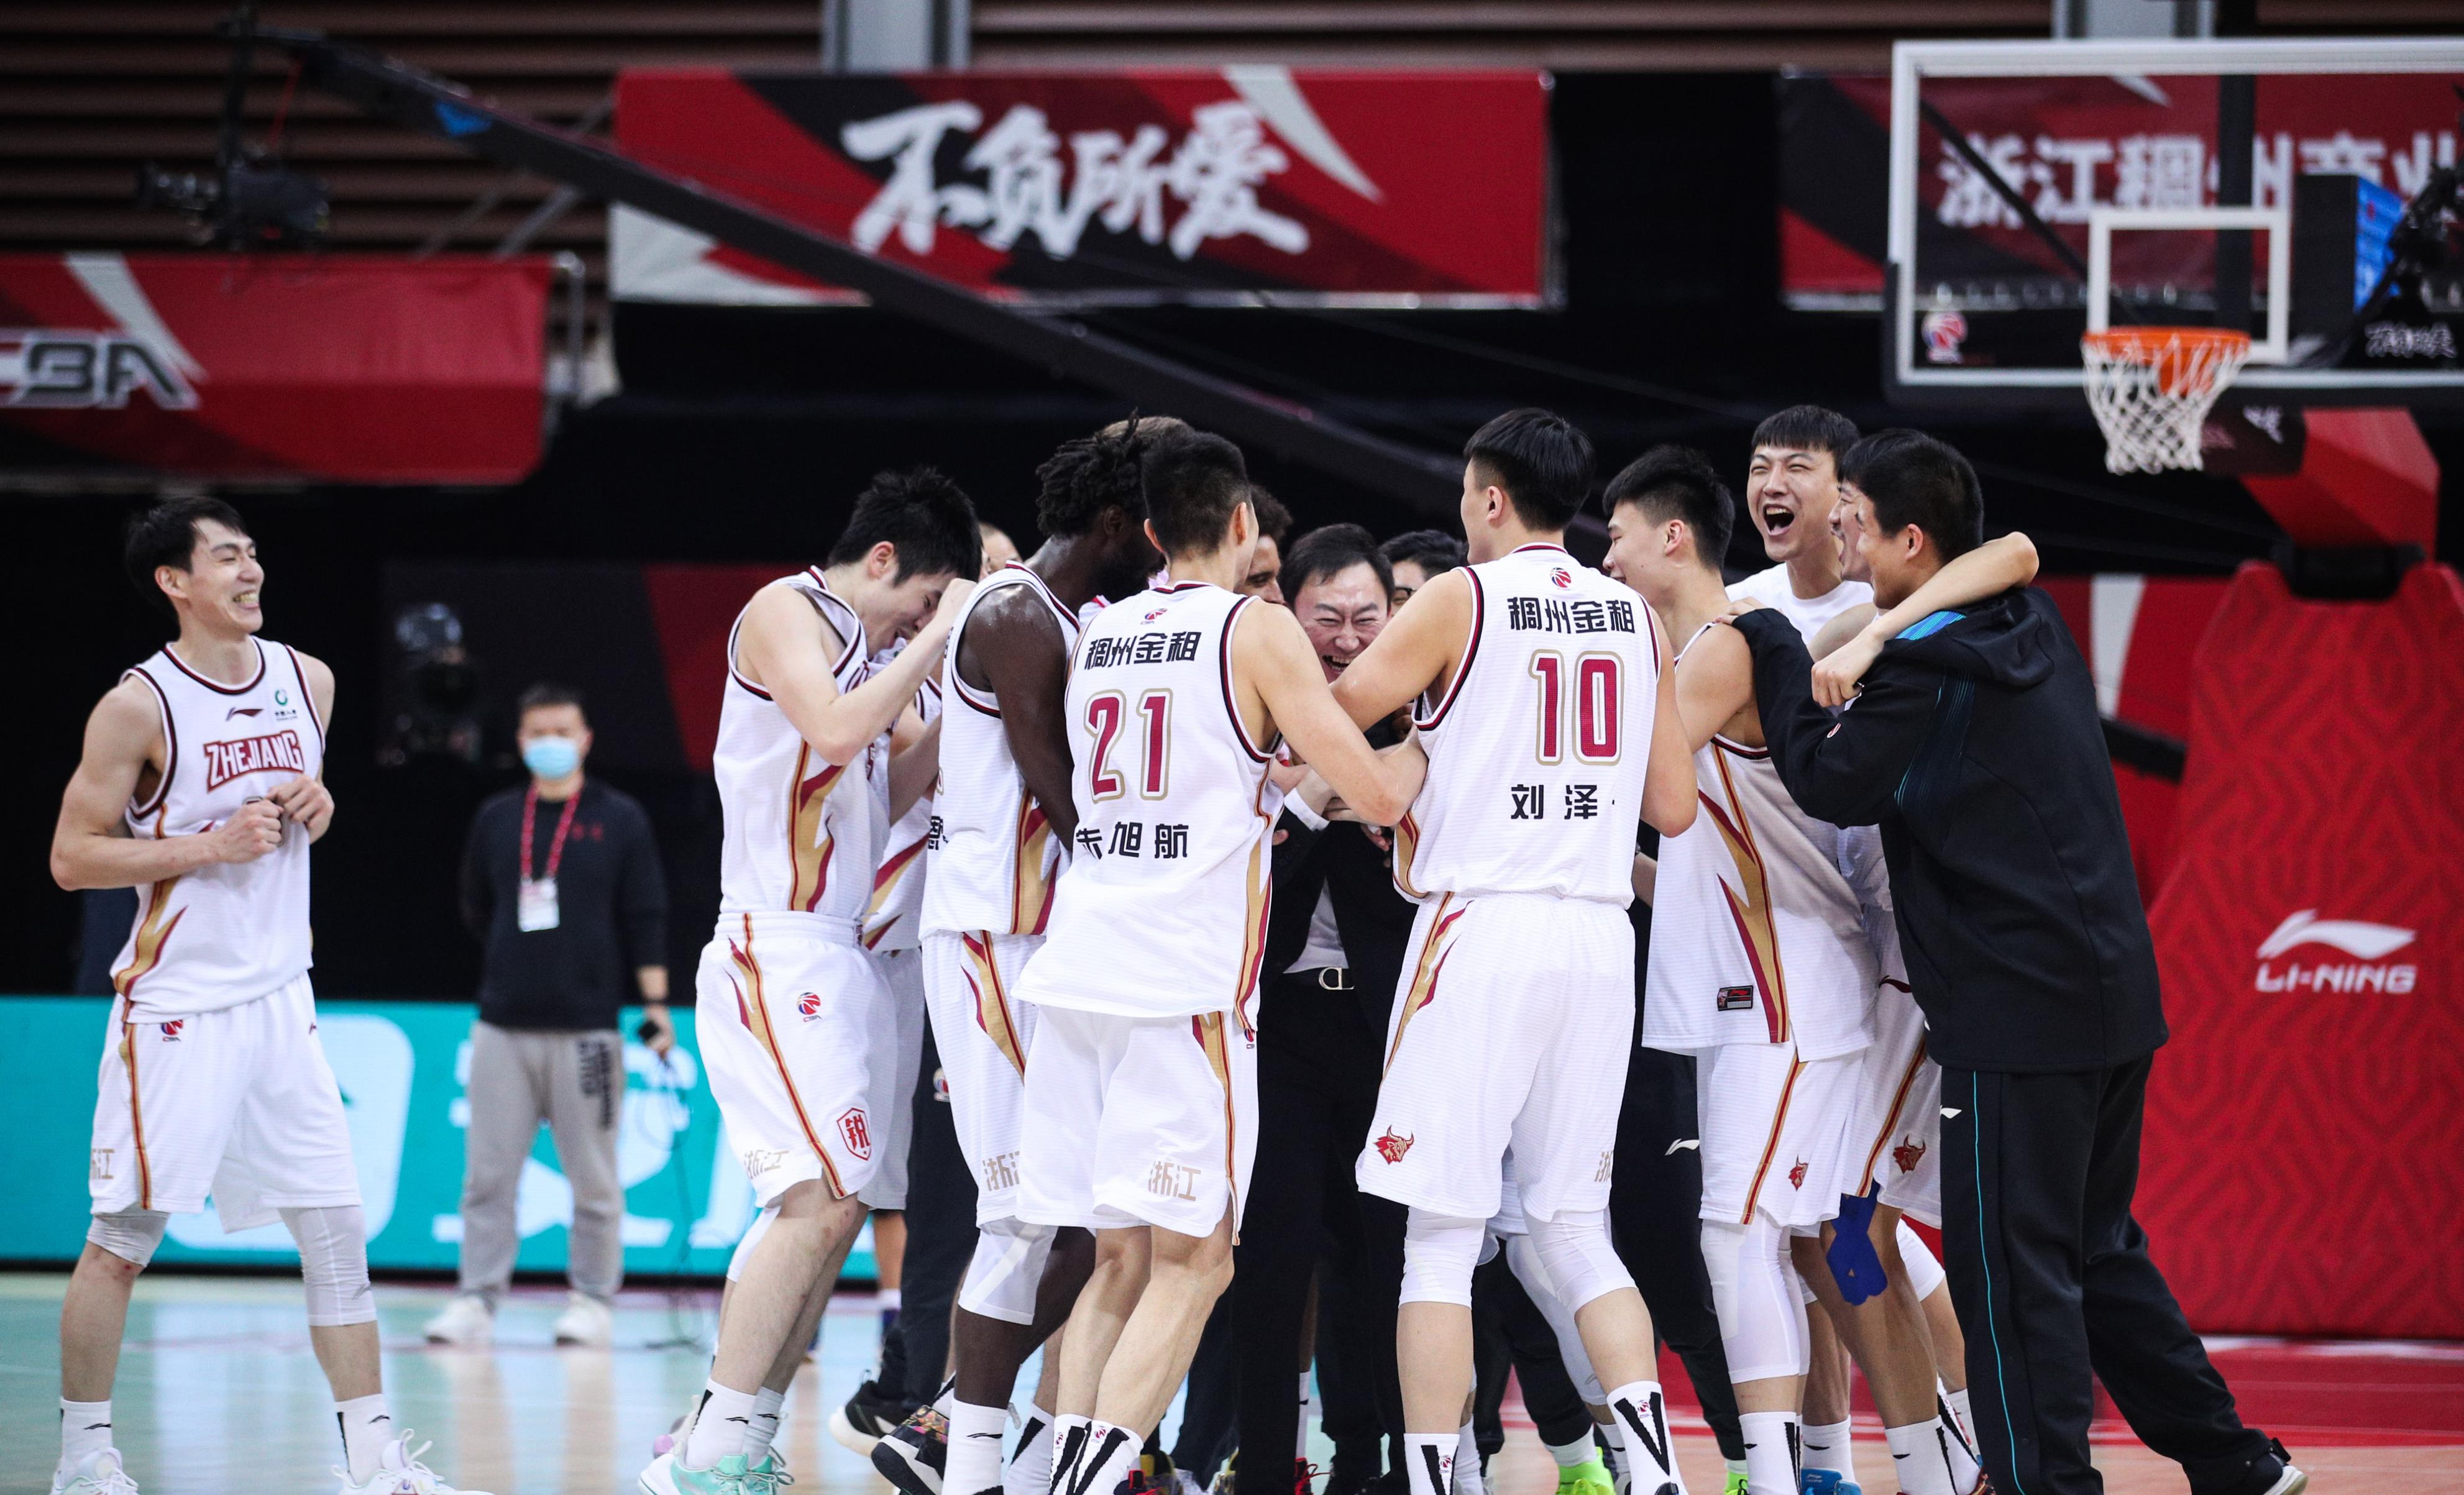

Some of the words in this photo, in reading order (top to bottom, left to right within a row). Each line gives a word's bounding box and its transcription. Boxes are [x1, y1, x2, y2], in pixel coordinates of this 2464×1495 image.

[842, 101, 1308, 258] 不负所爱
[1508, 597, 1635, 634] 稠州金租
[1084, 631, 1201, 670] 稠州金租
[1528, 649, 1624, 766] 10
[203, 729, 305, 794] ZHEJIANG
[1083, 688, 1173, 804] 21
[1511, 784, 1614, 820] 刘泽
[2256, 963, 2417, 994] LI-NING
[1147, 1160, 1201, 1202] 浙江
